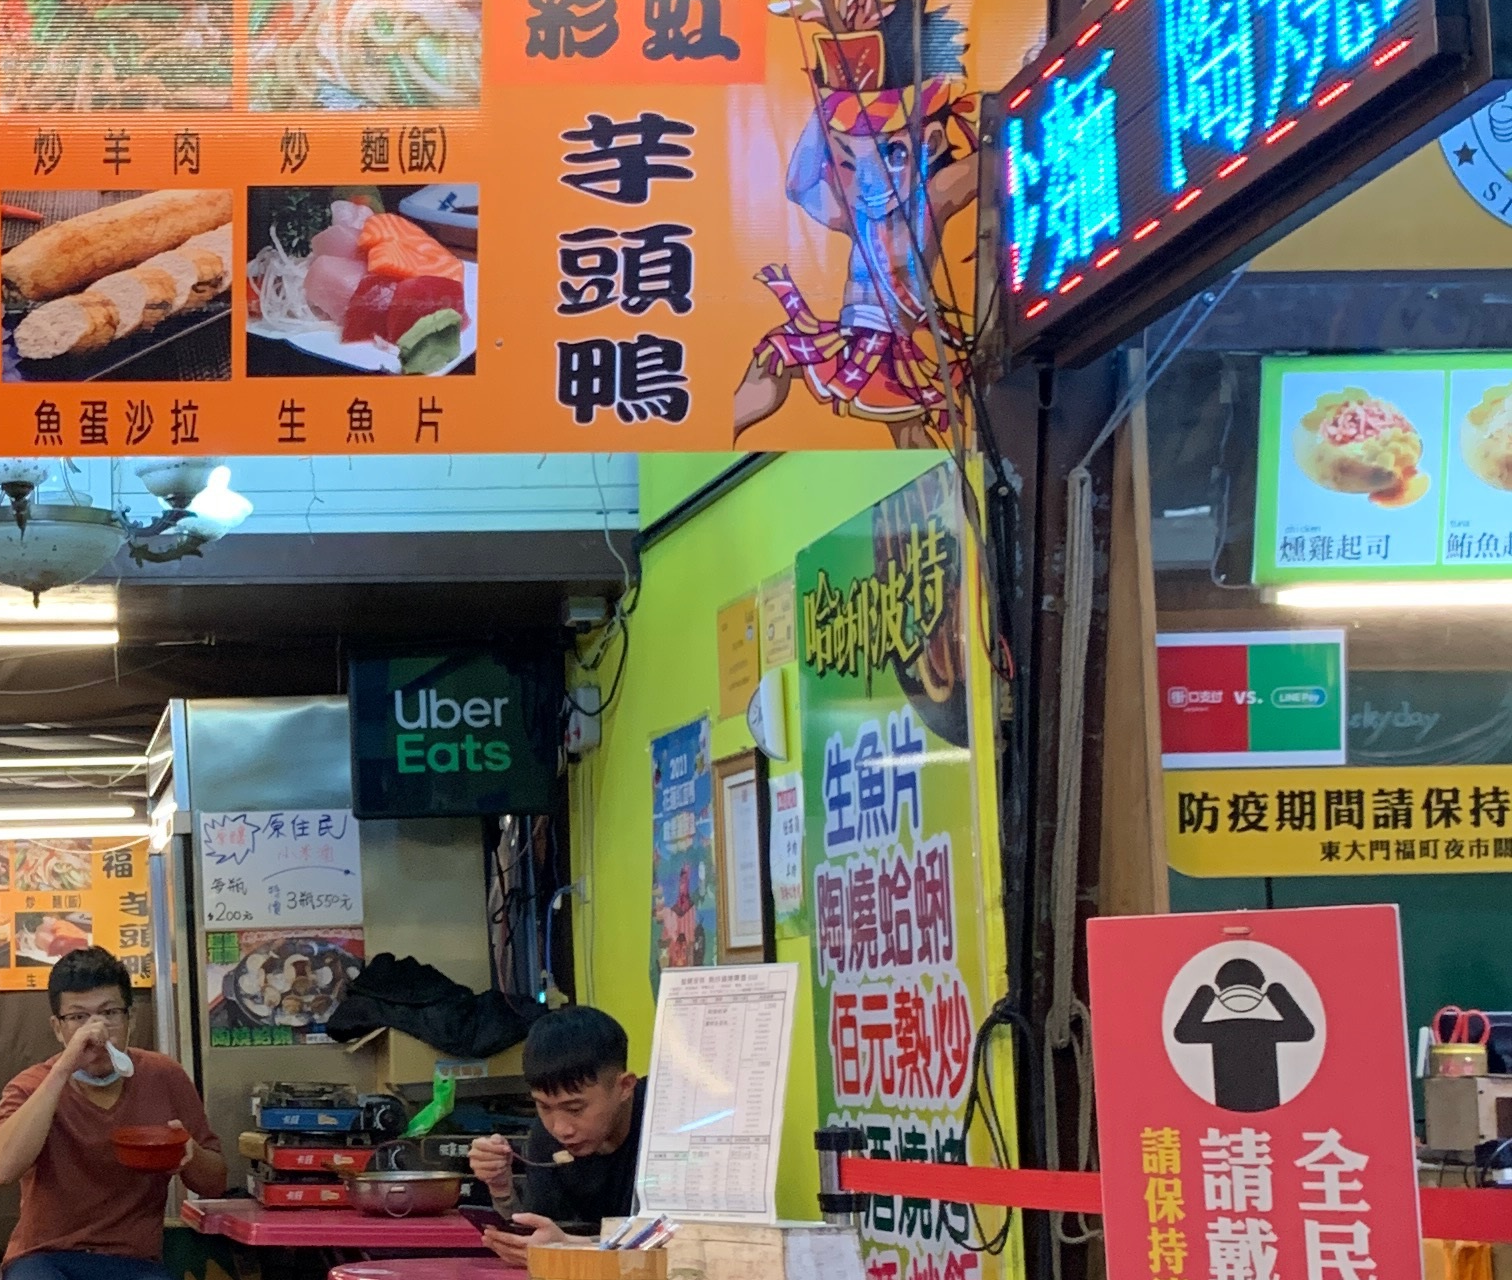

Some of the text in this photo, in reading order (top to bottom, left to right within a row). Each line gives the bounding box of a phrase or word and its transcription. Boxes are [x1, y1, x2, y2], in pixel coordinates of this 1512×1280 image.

[33, 128, 200, 175] 炒羊肉
[556, 111, 696, 425] 芋頭鴨
[33, 399, 199, 445] 魚蛋沙拉
[277, 396, 443, 444] 生魚片
[395, 689, 509, 730] Uber
[396, 733, 512, 774] Eats
[826, 717, 924, 846] 生魚片
[262, 813, 348, 841] 原住民
[1178, 787, 1510, 833] 防疫期間請保持
[287, 892, 352, 911] 3瓶550元
[817, 845, 951, 975] 陶燒蛤蜊
[831, 993, 971, 1100] 佰元熱炒
